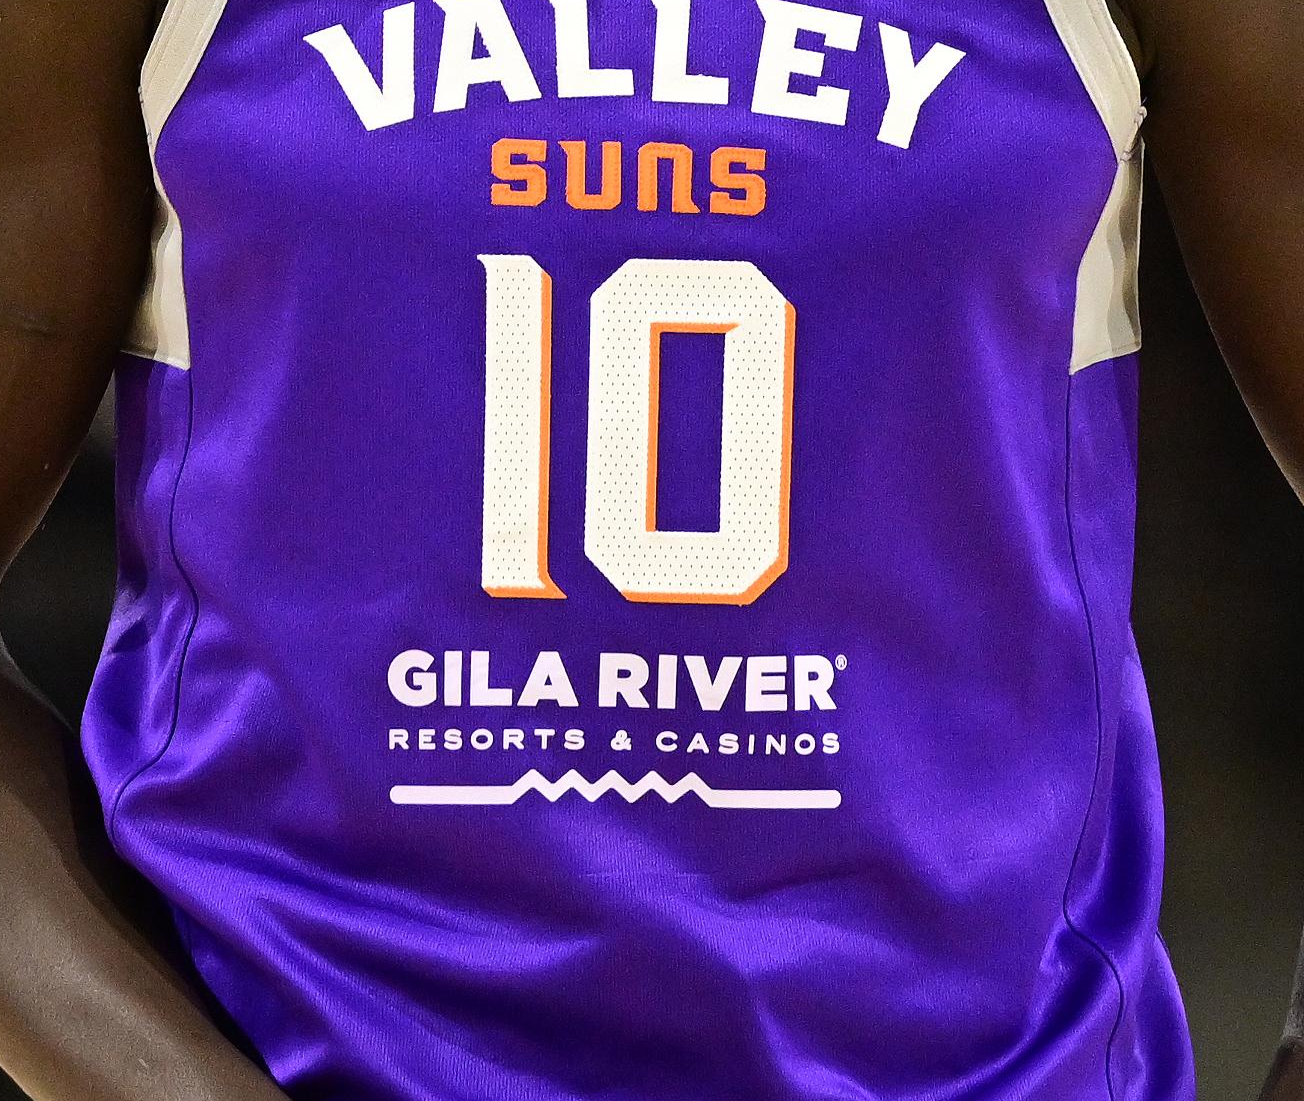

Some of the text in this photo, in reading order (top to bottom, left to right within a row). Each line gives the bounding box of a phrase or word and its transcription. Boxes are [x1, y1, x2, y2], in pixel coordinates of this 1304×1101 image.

[477, 254, 797, 606] 10
[387, 649, 579, 707] GILA
[388, 728, 841, 756] RESORTS & CASINOS
